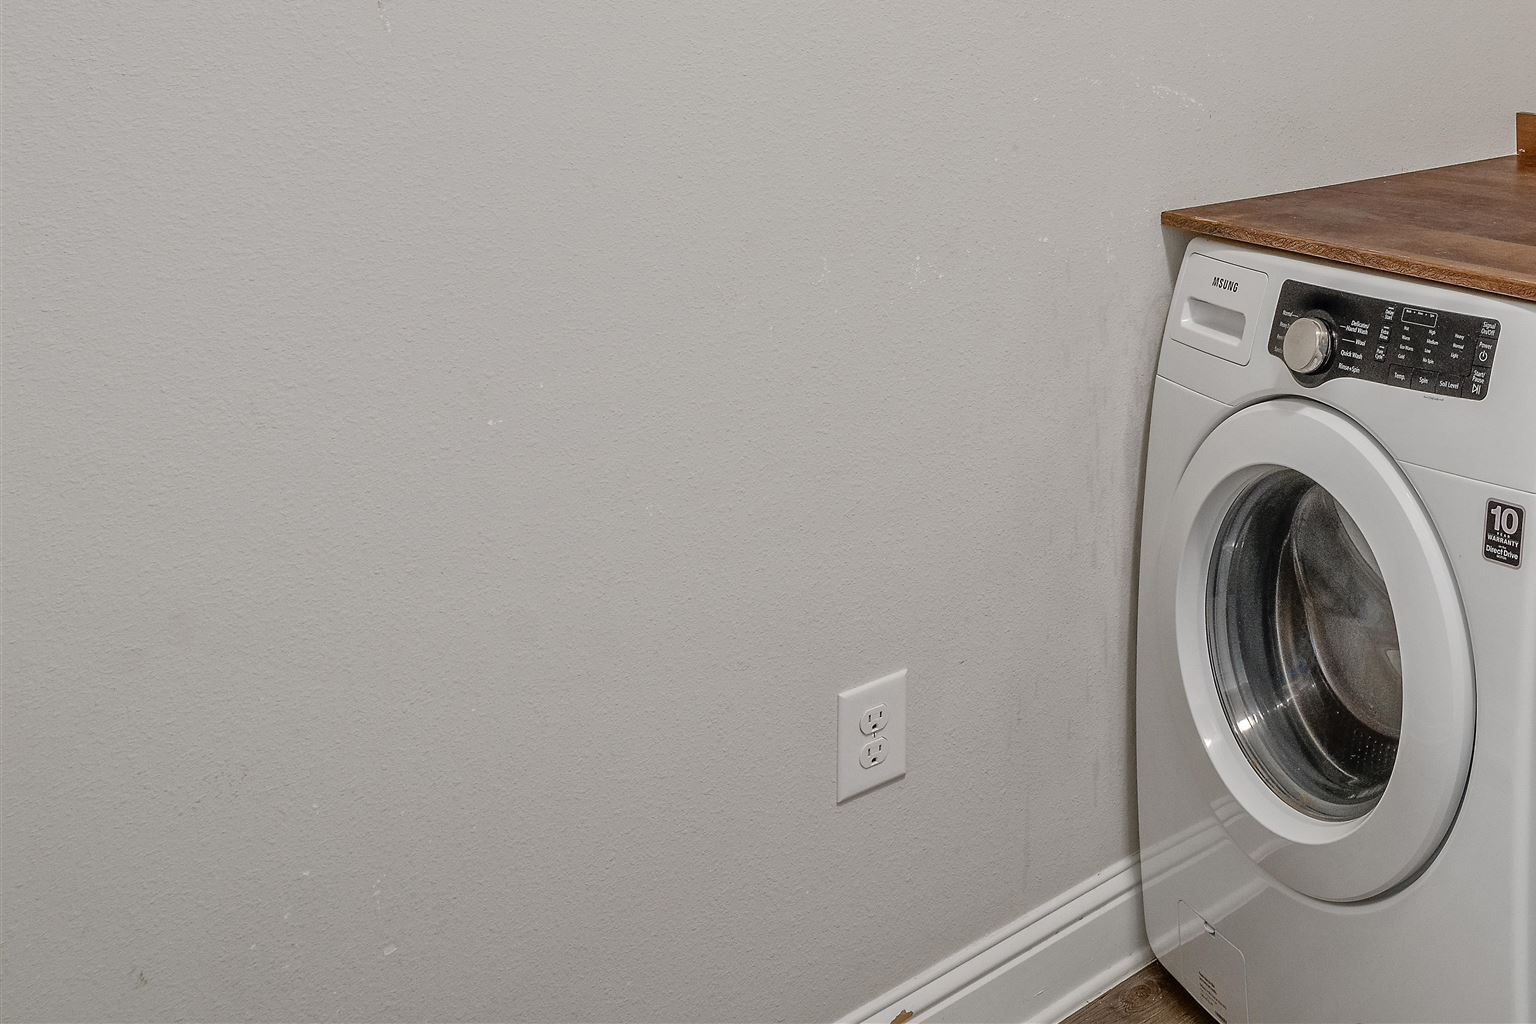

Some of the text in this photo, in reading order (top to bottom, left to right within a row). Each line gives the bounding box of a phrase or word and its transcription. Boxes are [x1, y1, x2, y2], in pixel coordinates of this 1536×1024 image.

[1483, 322, 1497, 330] Signal
[1481, 328, 1496, 336] On/Off
[1479, 342, 1492, 350] Power
[1472, 376, 1484, 384] Pause
[1491, 506, 1519, 534] 10
[1488, 534, 1519, 548] WARRANTY
[1486, 545, 1503, 555] Direct
[1504, 550, 1518, 560] Drive
